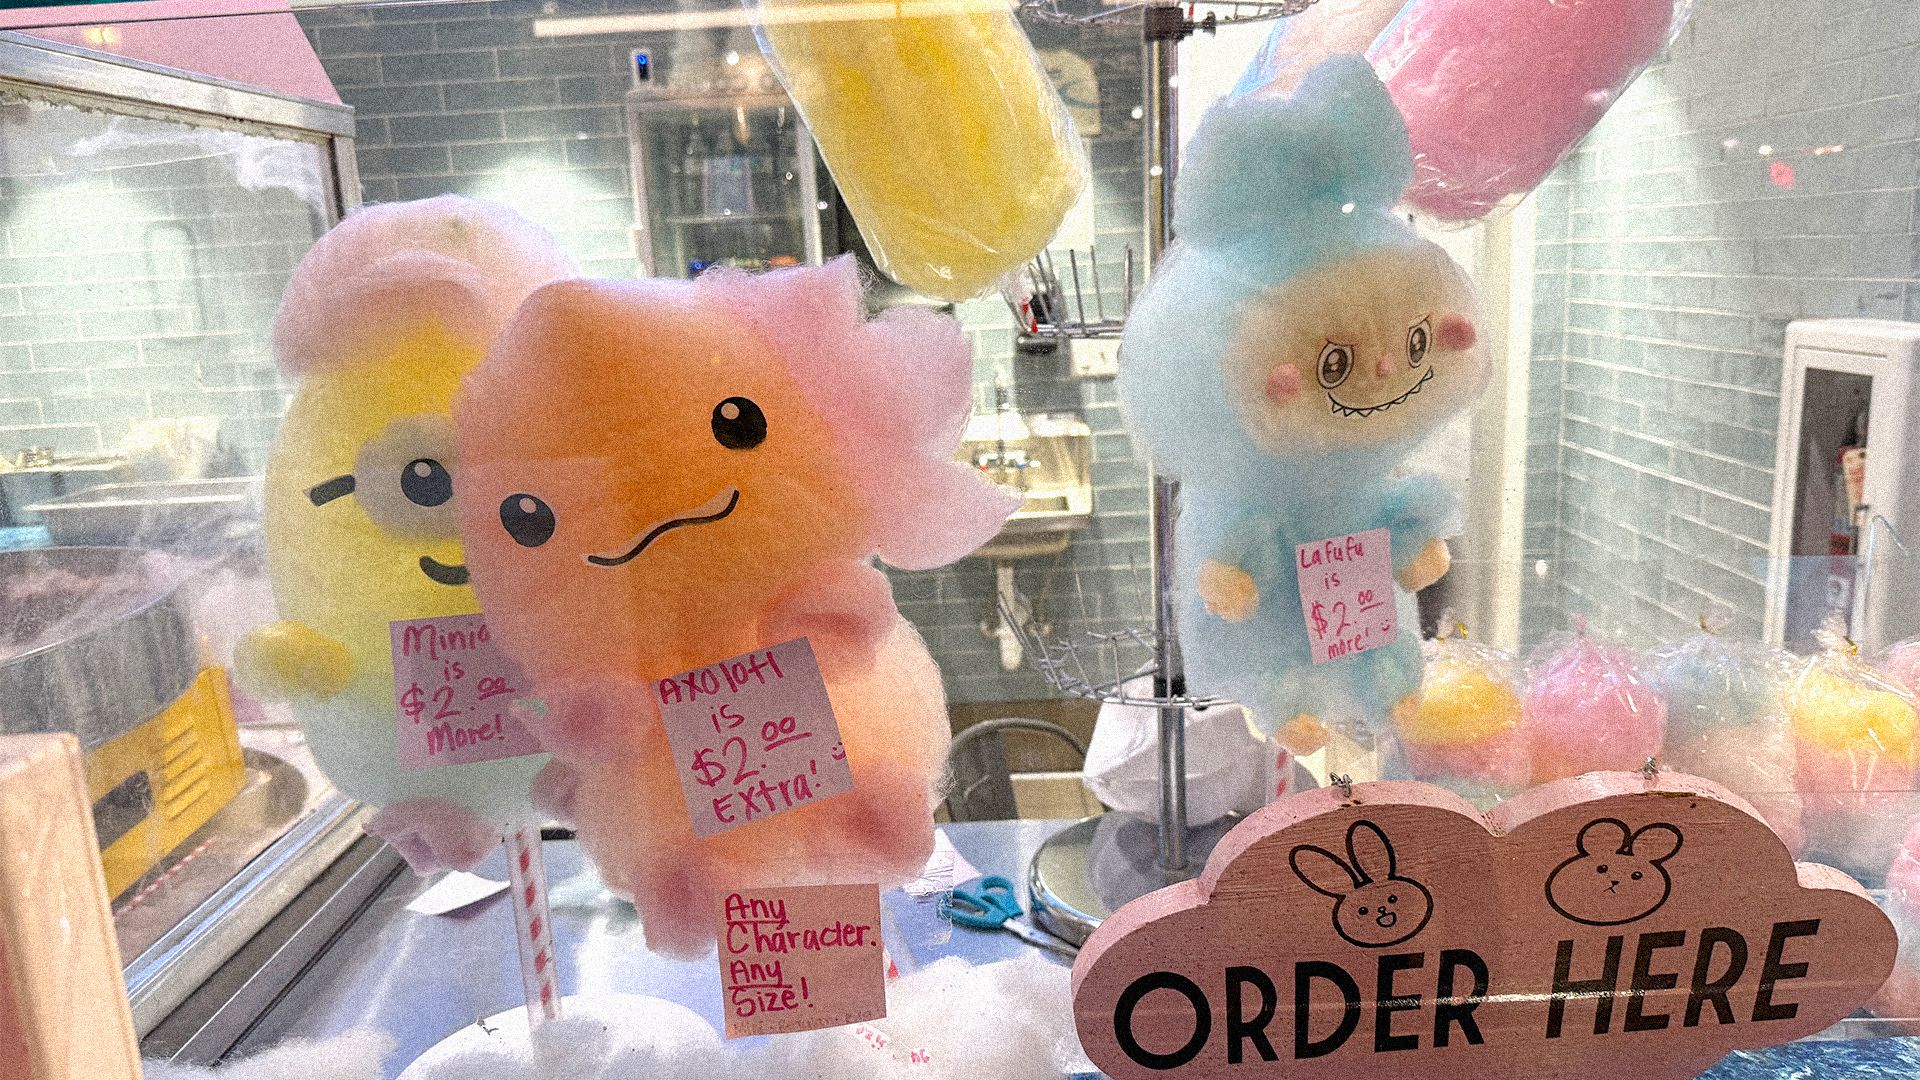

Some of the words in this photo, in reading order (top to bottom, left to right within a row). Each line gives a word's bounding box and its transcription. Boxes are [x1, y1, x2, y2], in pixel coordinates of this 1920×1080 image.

[1324, 572, 1341, 590] is
[403, 622, 491, 661] Minio
[444, 660, 465, 682] is
[426, 714, 505, 756] More!
[711, 704, 745, 734] is
[725, 893, 789, 927] Any
[726, 921, 877, 954] Character.
[728, 960, 792, 988] Any
[731, 976, 814, 1018] Size!
[1113, 948, 1490, 1070] ORDER
[1545, 918, 1822, 1039] HERE
